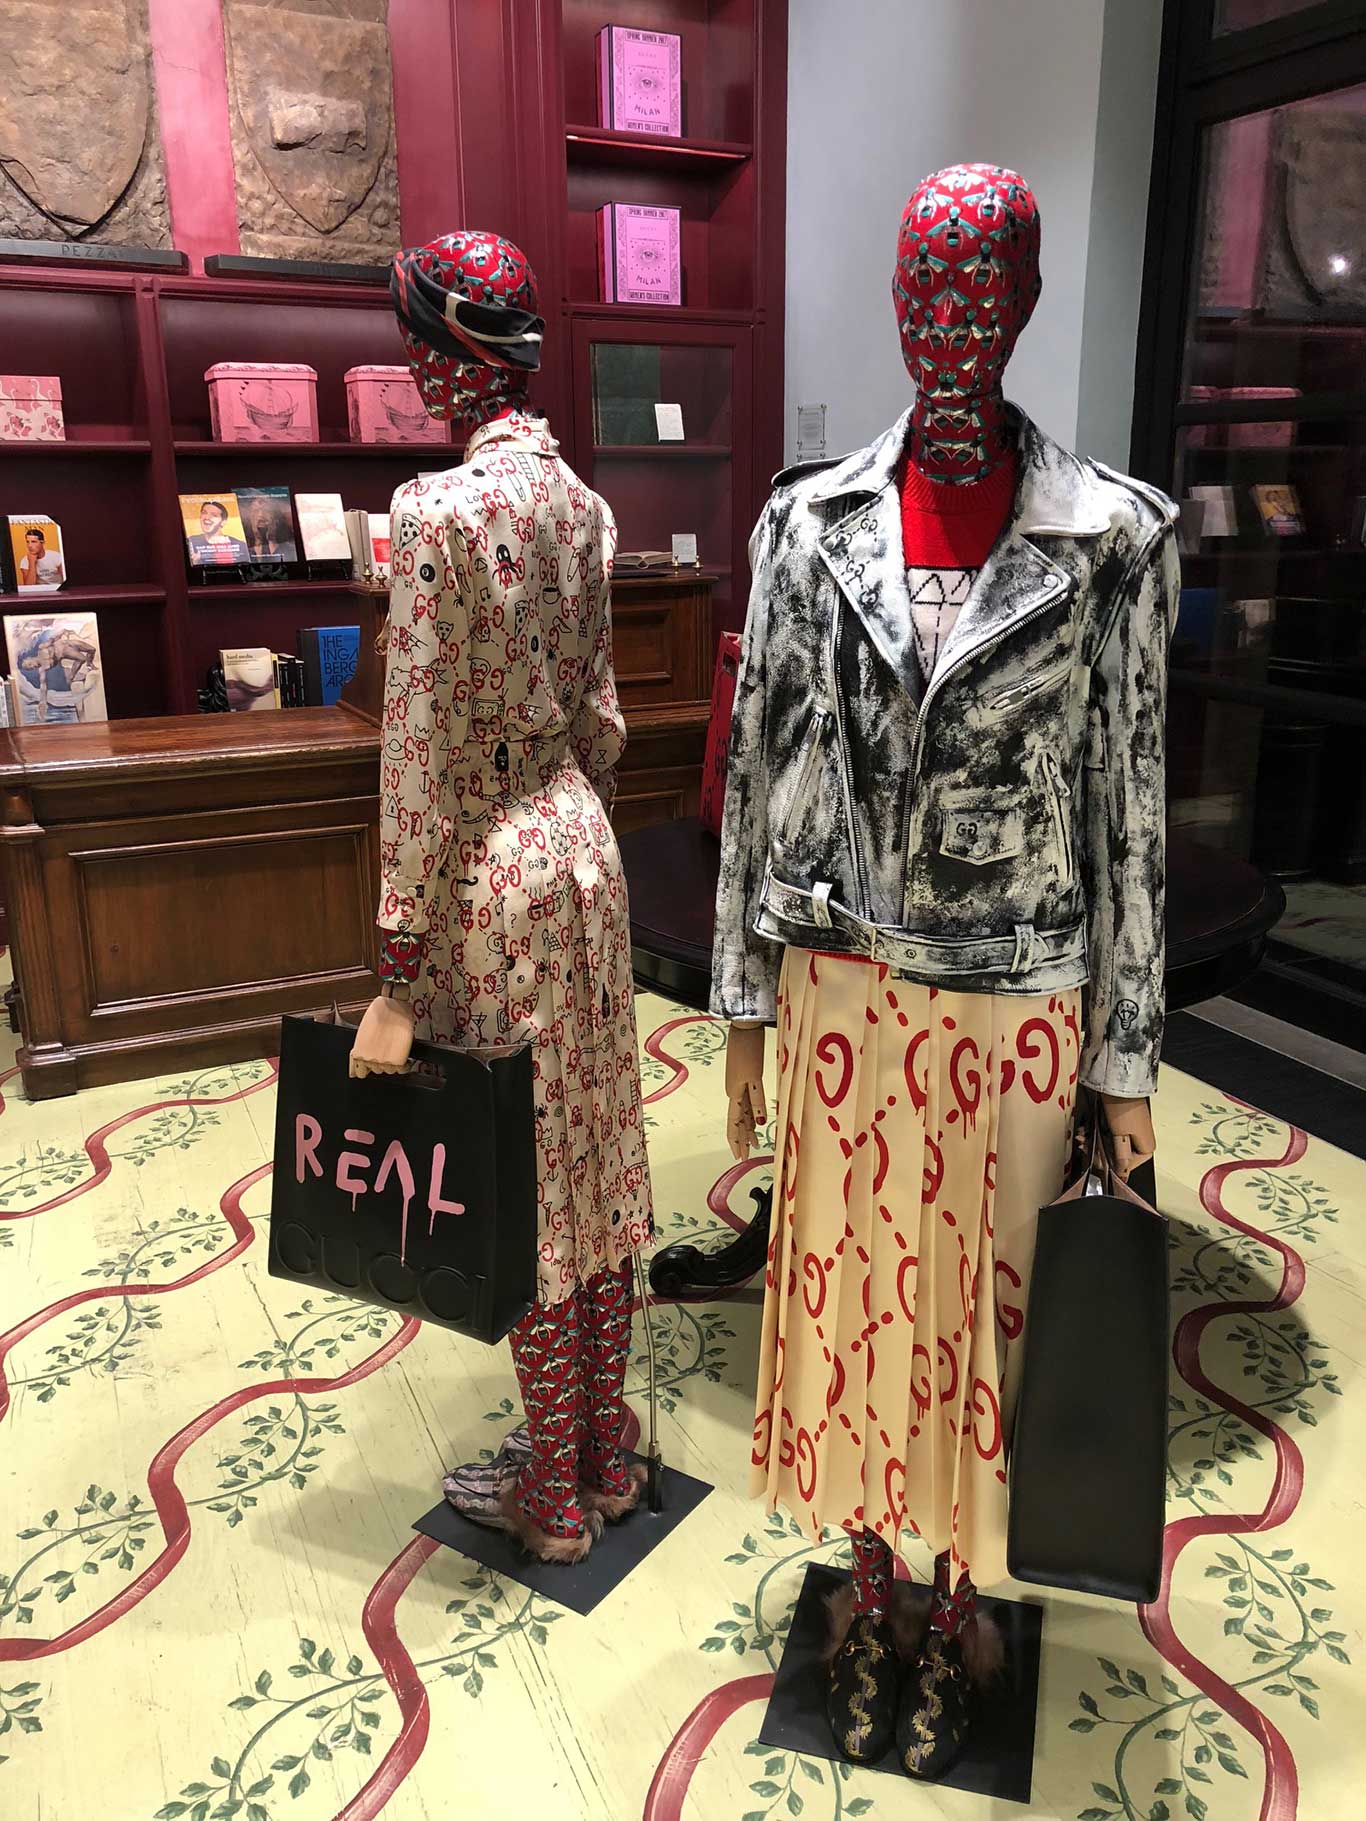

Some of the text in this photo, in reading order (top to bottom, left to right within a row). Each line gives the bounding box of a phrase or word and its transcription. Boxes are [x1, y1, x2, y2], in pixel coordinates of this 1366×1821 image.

[626, 31, 641, 41] SPRING
[641, 33, 657, 43] SUMMER
[633, 104, 661, 116] MILAN
[627, 121, 669, 133] WOMEN'S COLLECTION
[636, 274, 662, 285] MILAN
[646, 291, 670, 301] COLLECTION
[321, 635, 343, 649] THE
[295, 1112, 466, 1228] REAL
[275, 1220, 487, 1332] GUCCI
